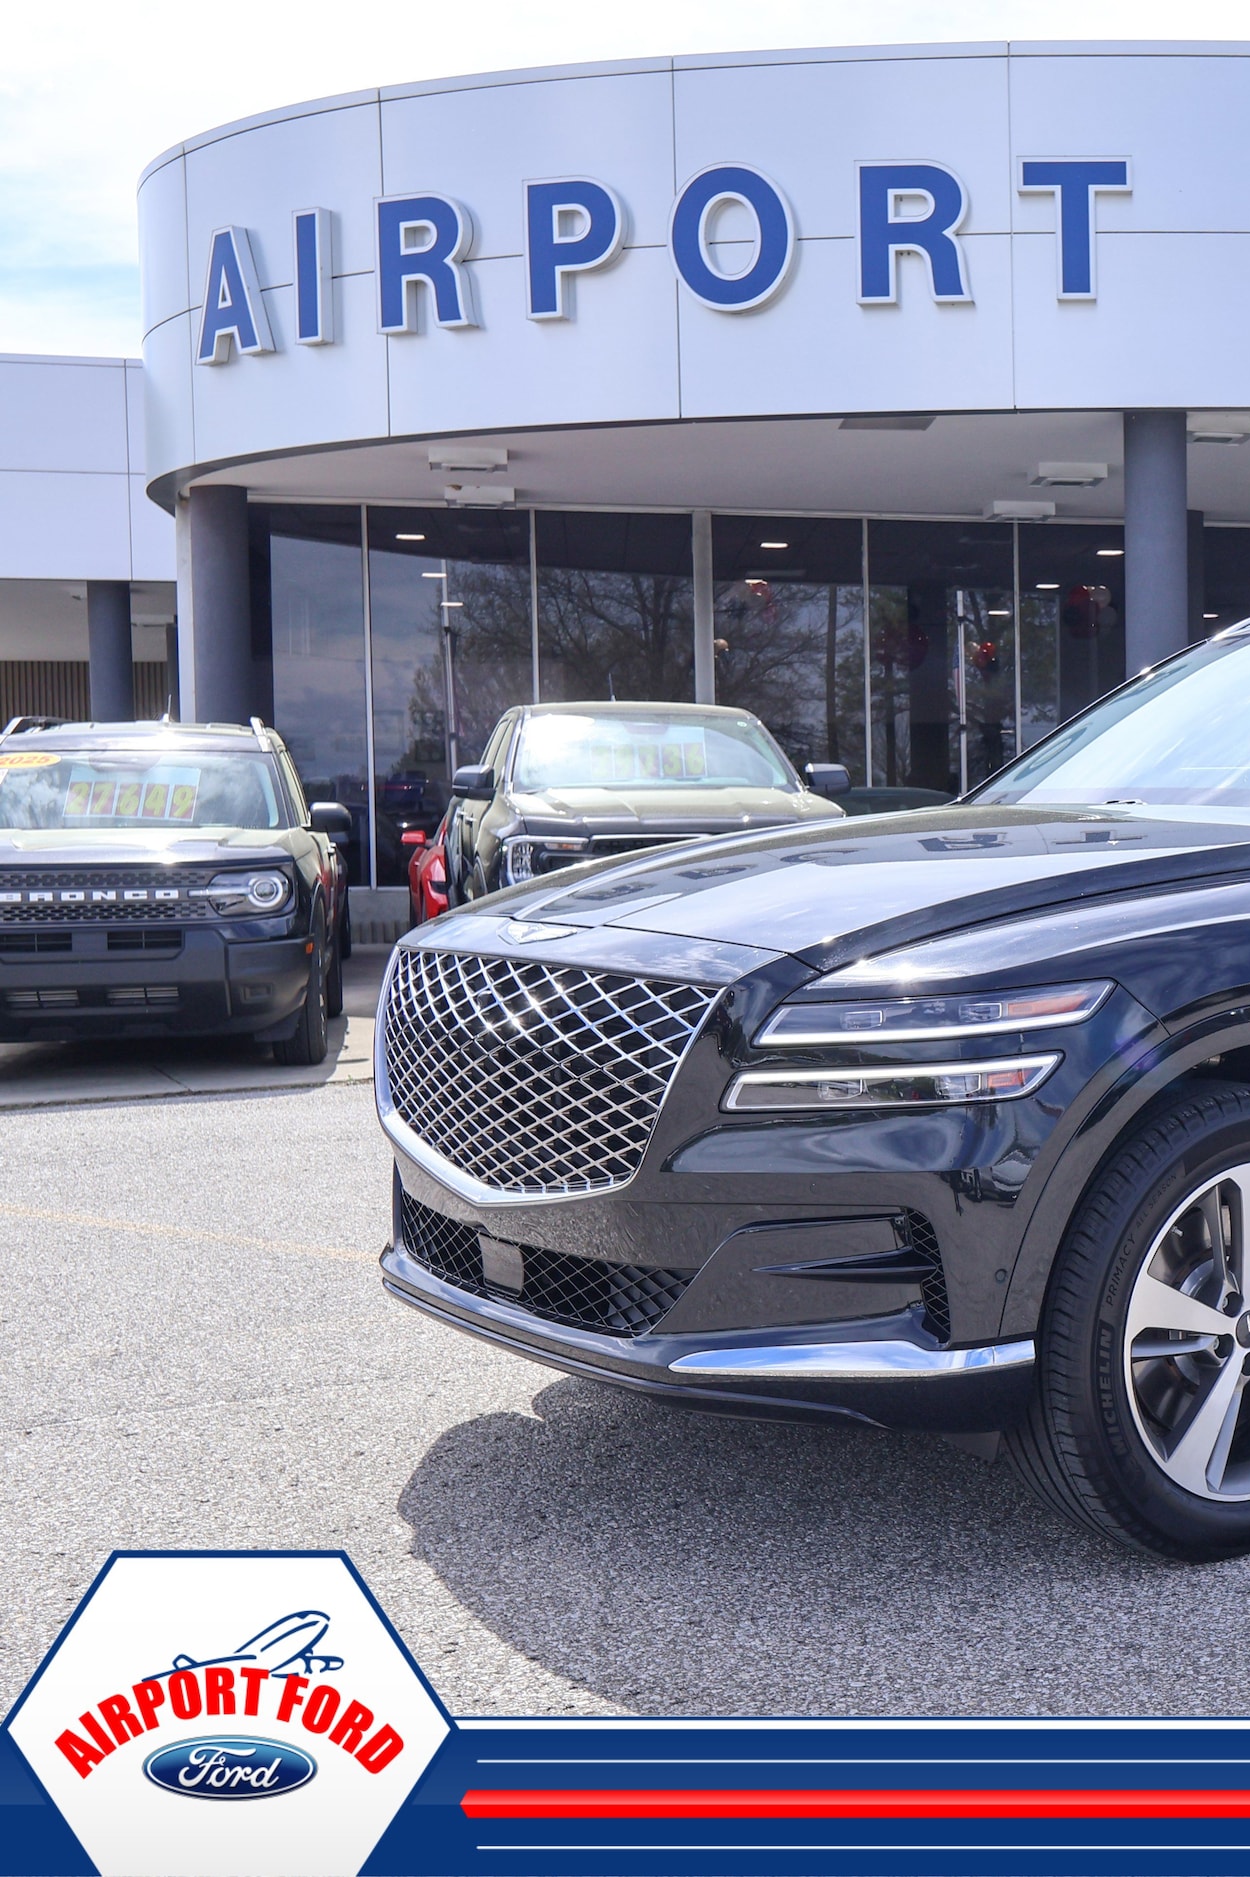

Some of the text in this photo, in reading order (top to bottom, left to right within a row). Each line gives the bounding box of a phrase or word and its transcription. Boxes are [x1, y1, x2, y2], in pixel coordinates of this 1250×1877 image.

[196, 154, 1133, 367] AIRPORT
[65, 782, 194, 818] 27649
[1105, 1173, 1178, 1306] PRIMACY ALL SEASON
[1099, 1327, 1127, 1457] MICHELIN
